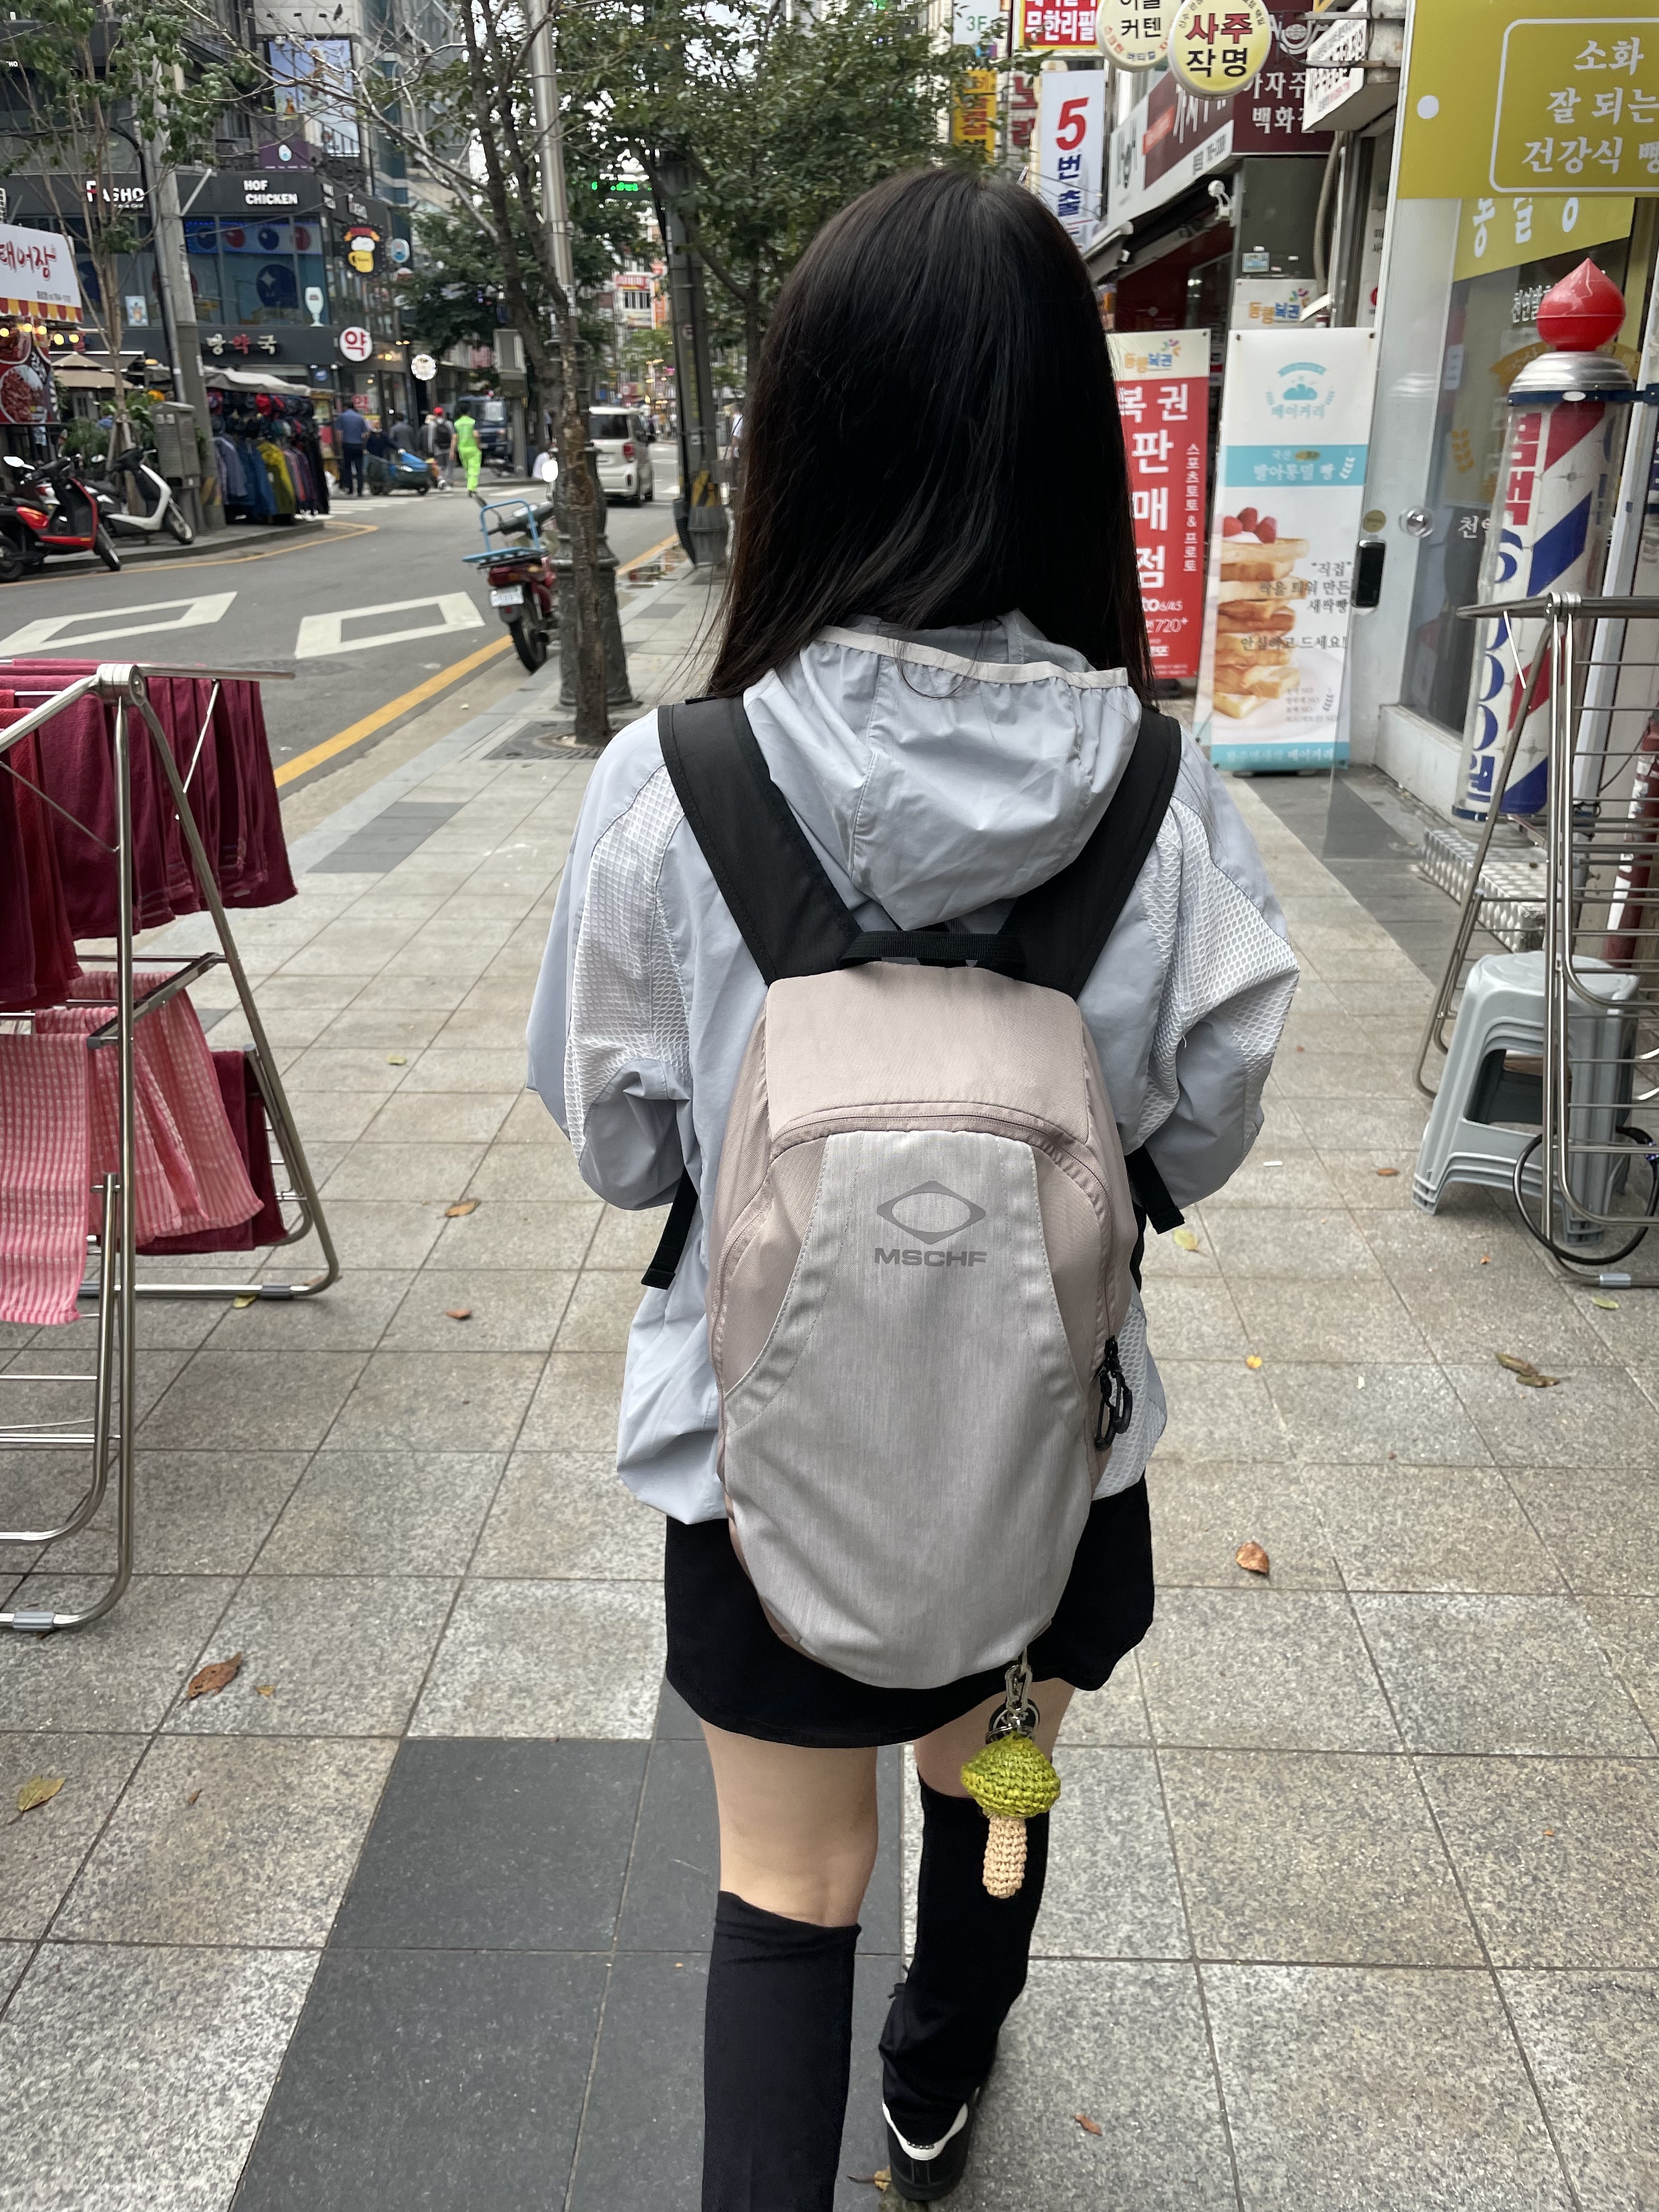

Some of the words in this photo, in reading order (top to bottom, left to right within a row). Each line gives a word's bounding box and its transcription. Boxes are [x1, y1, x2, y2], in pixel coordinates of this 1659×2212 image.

[967, 16, 987, 31] 3F
[1025, 10, 1096, 42] 무한리필
[1121, 17, 1161, 39] 커텐
[1185, 13, 1253, 45] 사주
[1186, 48, 1248, 78] 작명
[1573, 37, 1645, 75] 소화
[1547, 87, 1581, 124] 잘
[1592, 87, 1659, 125] 되는
[1522, 137, 1623, 174] 건강식
[243, 180, 268, 191] HOF
[245, 194, 298, 205] CHICKEN
[345, 331, 369, 357] 약
[1119, 383, 1188, 424] 복권
[1271, 404, 1325, 420] 베이커리
[1184, 443, 1200, 512] 스포츠토토
[1319, 463, 1335, 481] 빵
[1186, 515, 1197, 528] &
[1183, 532, 1198, 572] 프로토
[1323, 580, 1351, 595] 만든
[1307, 599, 1348, 614] 새싹빵
[1240, 635, 1294, 651] 안심하고
[874, 1248, 987, 1267] MSCHF
